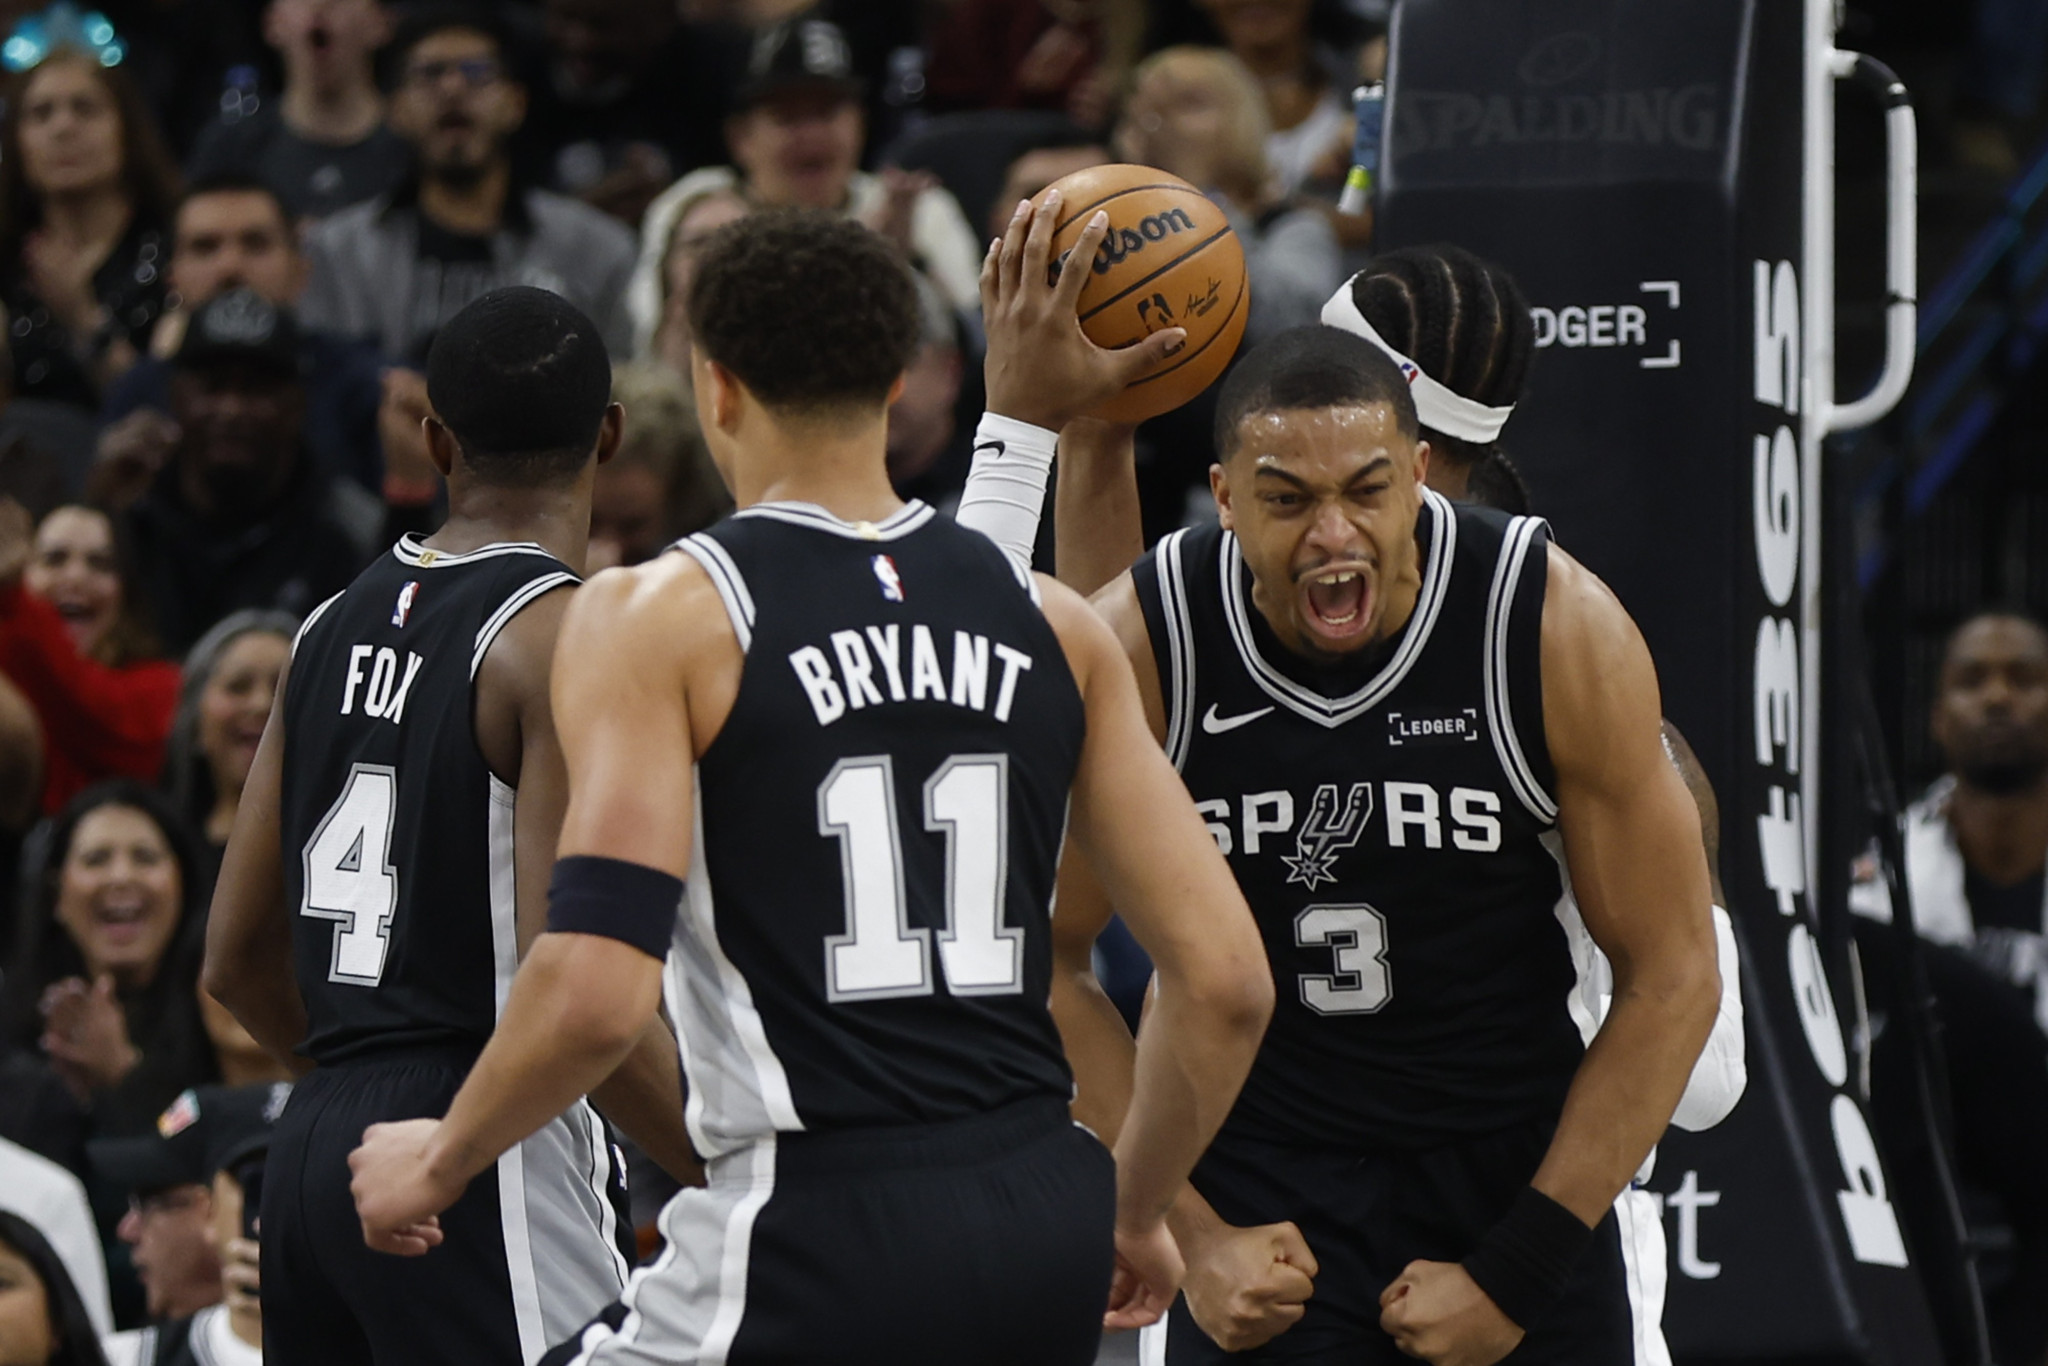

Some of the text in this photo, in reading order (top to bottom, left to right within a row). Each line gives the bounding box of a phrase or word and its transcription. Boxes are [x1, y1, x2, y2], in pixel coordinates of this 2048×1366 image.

[1393, 83, 1717, 159] SPALDING
[1529, 304, 1648, 348] DGER
[340, 644, 424, 725] FOX
[789, 624, 1032, 726] BRYANT
[1400, 718, 1466, 736] LEDGER
[1754, 260, 1908, 1266] bet365
[301, 762, 399, 988] 4
[817, 752, 1025, 1003] 11
[1293, 902, 1394, 1016] 3
